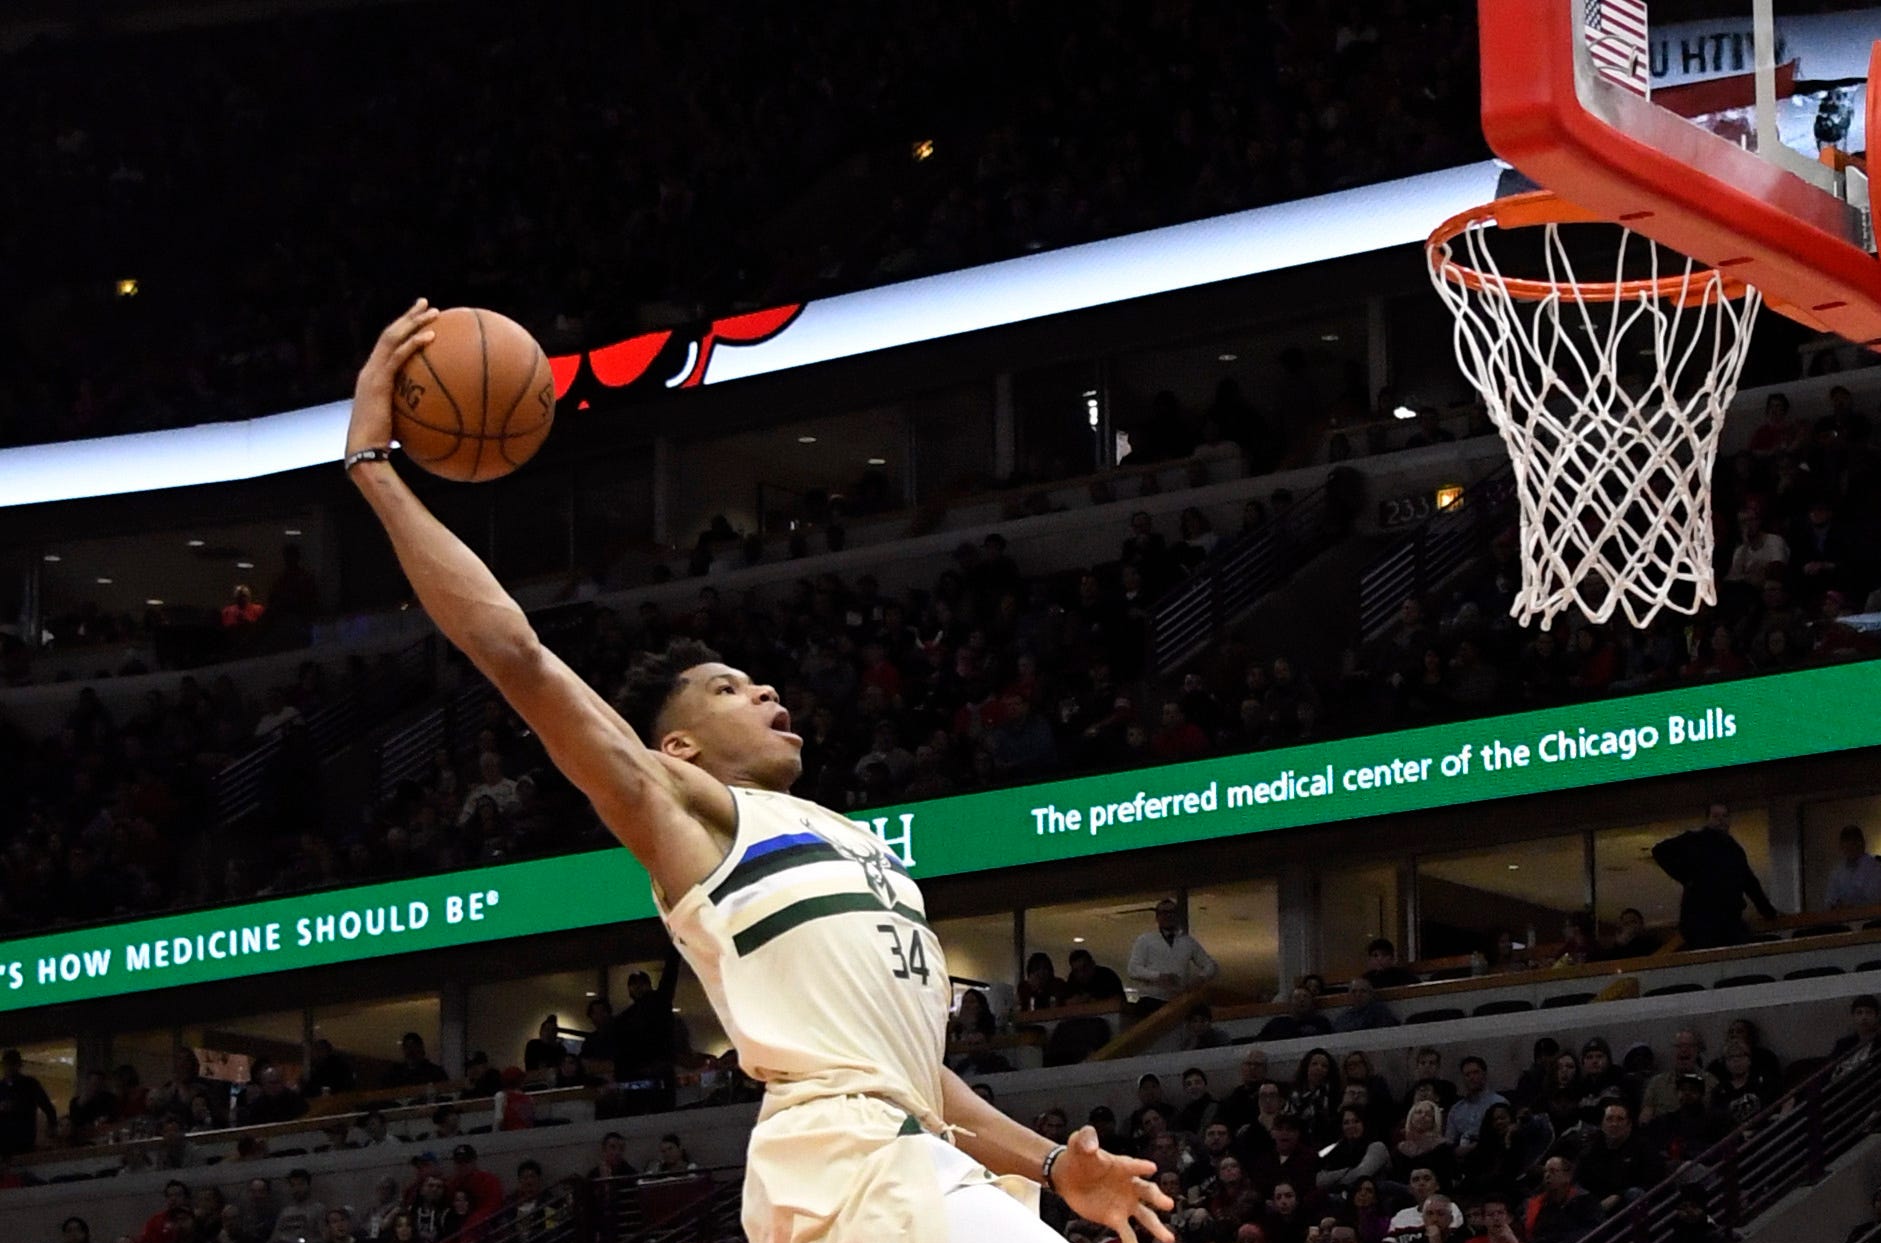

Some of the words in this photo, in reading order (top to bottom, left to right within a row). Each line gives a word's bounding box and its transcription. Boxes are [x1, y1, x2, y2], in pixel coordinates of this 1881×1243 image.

[1031, 805, 1082, 835] The
[1090, 781, 1217, 836] preferred
[1227, 764, 1333, 808] medical
[1342, 758, 1433, 791] center
[1441, 744, 1472, 777] of
[1480, 740, 1531, 771] the
[1538, 726, 1659, 762] Chicago
[1668, 707, 1737, 745] Bulls
[38, 949, 111, 984] HOW
[126, 923, 280, 971] MEDICINE
[297, 901, 429, 946] SHOULD
[877, 924, 930, 986] 34
